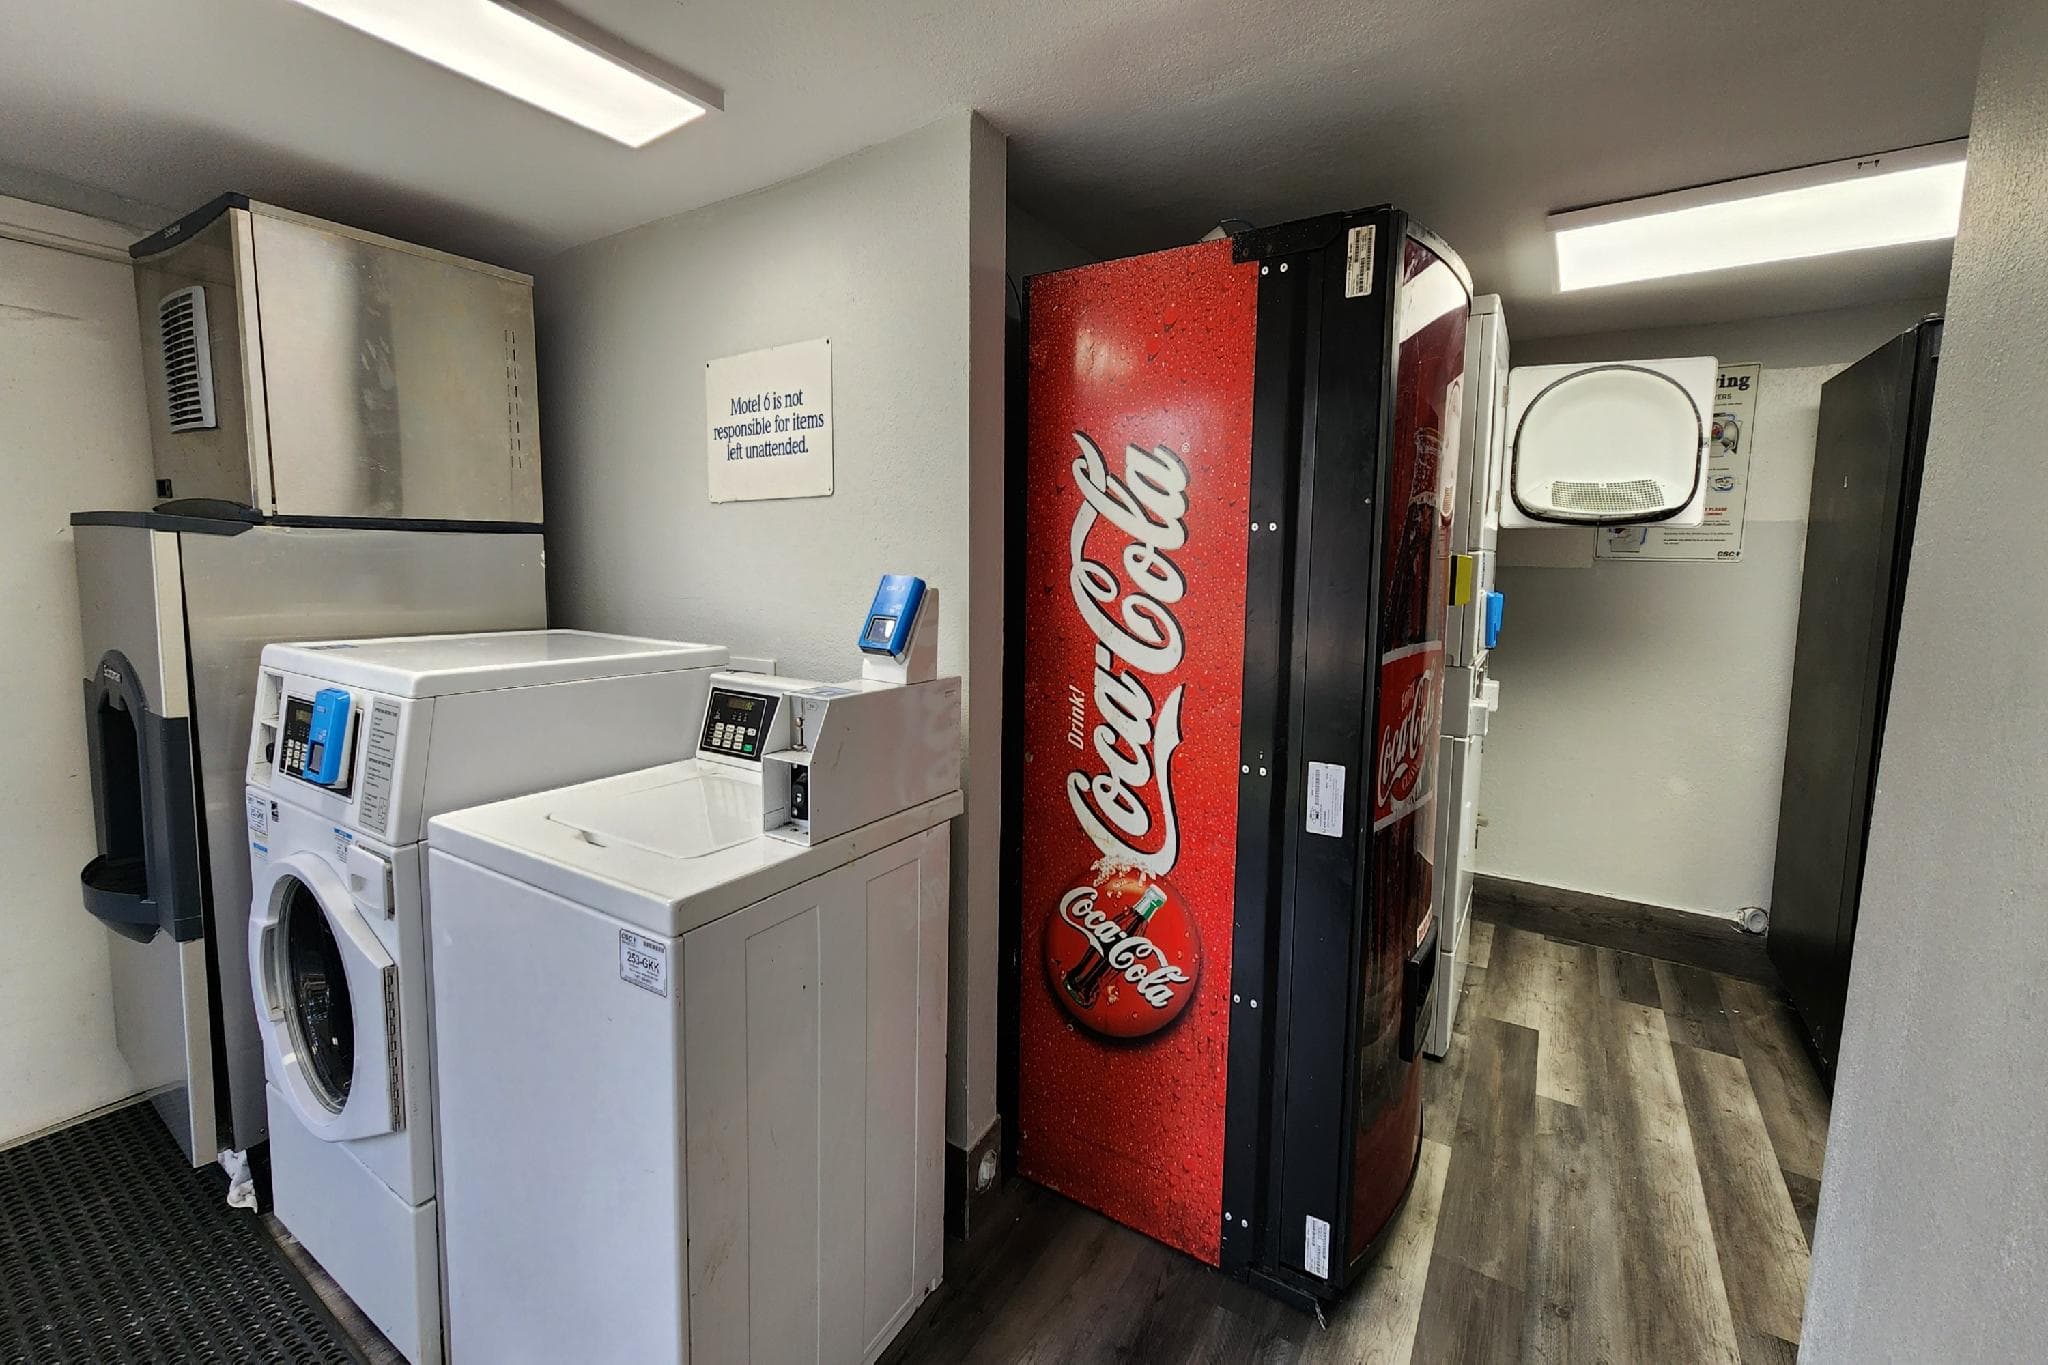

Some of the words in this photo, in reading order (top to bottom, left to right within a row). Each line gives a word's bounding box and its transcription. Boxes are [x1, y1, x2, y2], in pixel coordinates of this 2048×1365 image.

[1716, 374, 1751, 391] ing
[730, 394, 761, 416] Motel
[763, 392, 771, 411] 6
[773, 391, 782, 410] is
[785, 389, 803, 408] not
[713, 415, 772, 443] responsible
[774, 414, 790, 433] for
[792, 413, 824, 431] items
[727, 442, 743, 461] left
[746, 435, 809, 459] unattended.
[1069, 431, 1190, 876] Coca-Cola
[1066, 684, 1087, 751] Drink!
[1059, 886, 1190, 1009] Coca-Cola
[626, 951, 660, 974] 253-GKK
